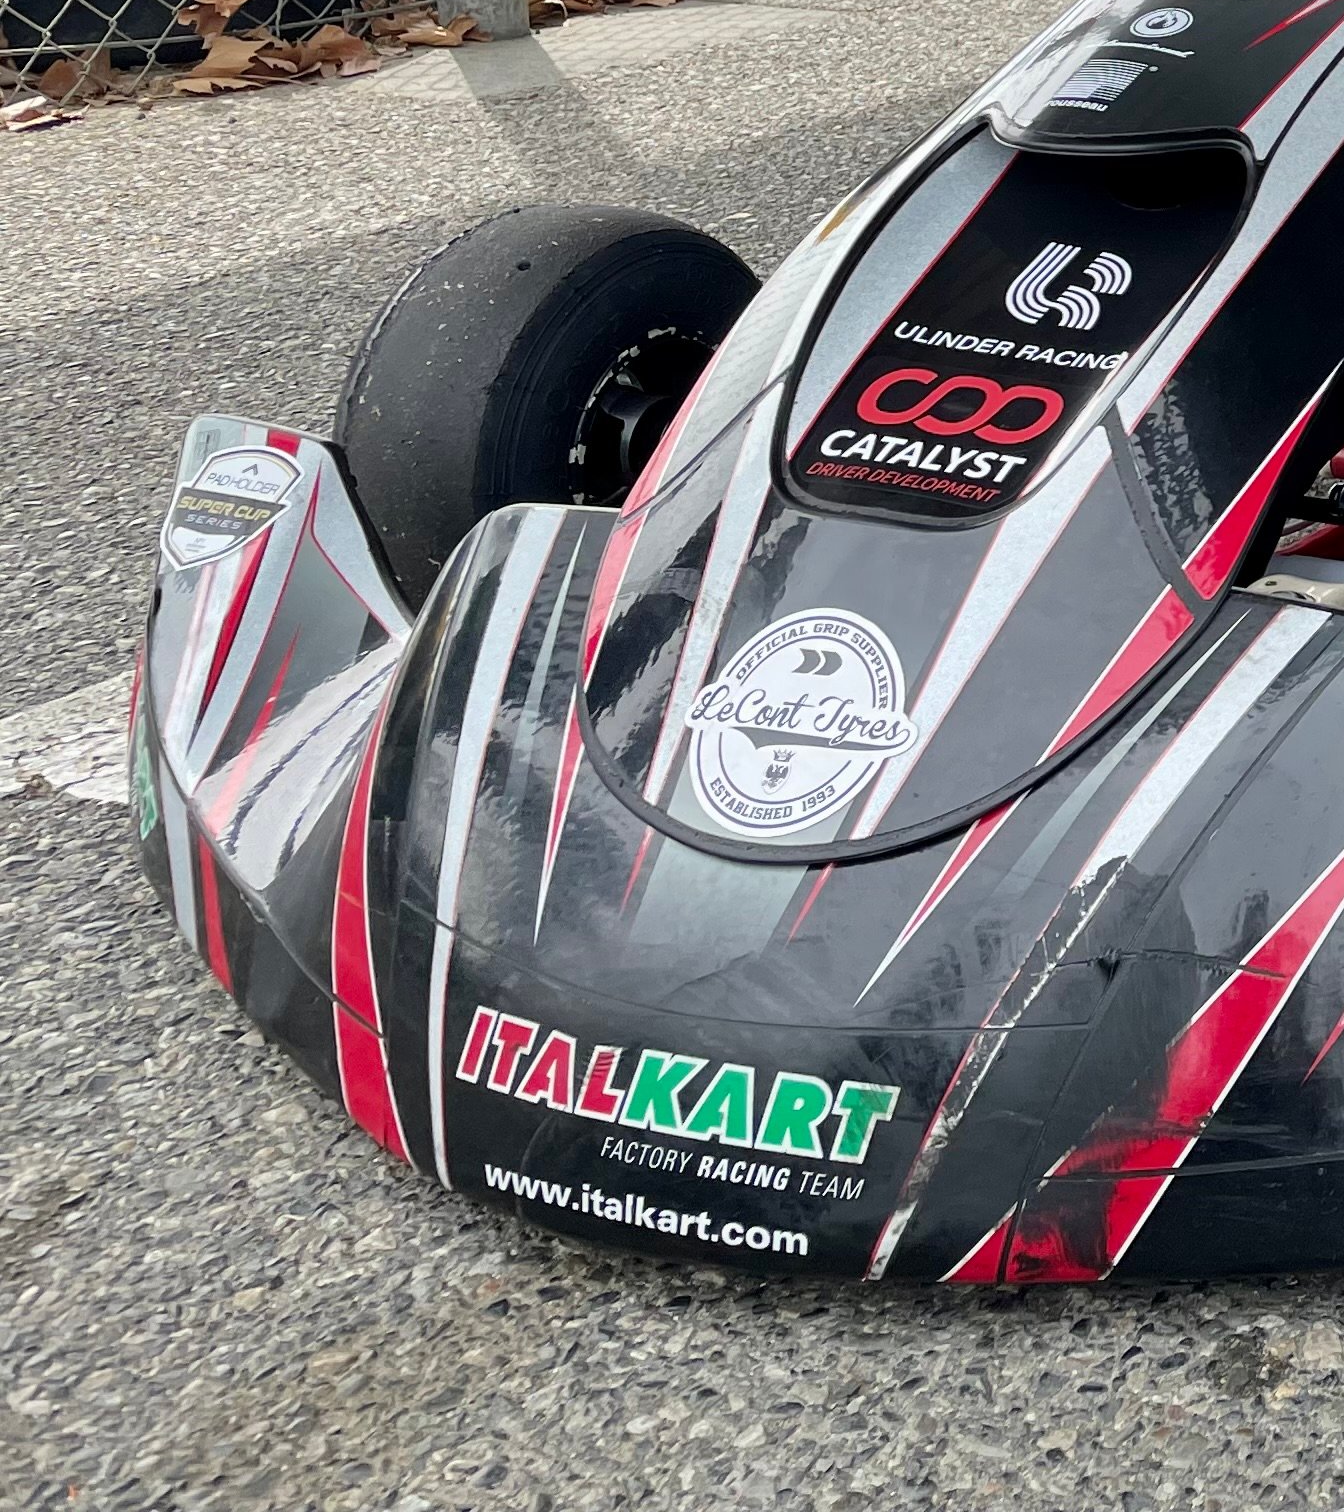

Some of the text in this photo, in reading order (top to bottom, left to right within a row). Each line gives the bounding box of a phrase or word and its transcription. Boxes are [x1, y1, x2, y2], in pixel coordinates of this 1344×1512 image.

[893, 320, 1129, 371] ULINDER RACING
[806, 461, 1002, 504] DRIVER DEVELOPMENT
[819, 428, 1028, 484] CATALYST
[177, 495, 272, 521] SUPER CUP
[184, 513, 243, 530] SERIES
[735, 622, 890, 710] OFFICIAL GRIP SUPPLIER
[691, 684, 911, 747] LeCont Tyres
[710, 777, 837, 821] ESTABLISHED 1993
[455, 1005, 901, 1167] ITALKART
[600, 1135, 866, 1202] FACTORY RACING TEAM
[484, 1162, 810, 1258] www.italkart.com
